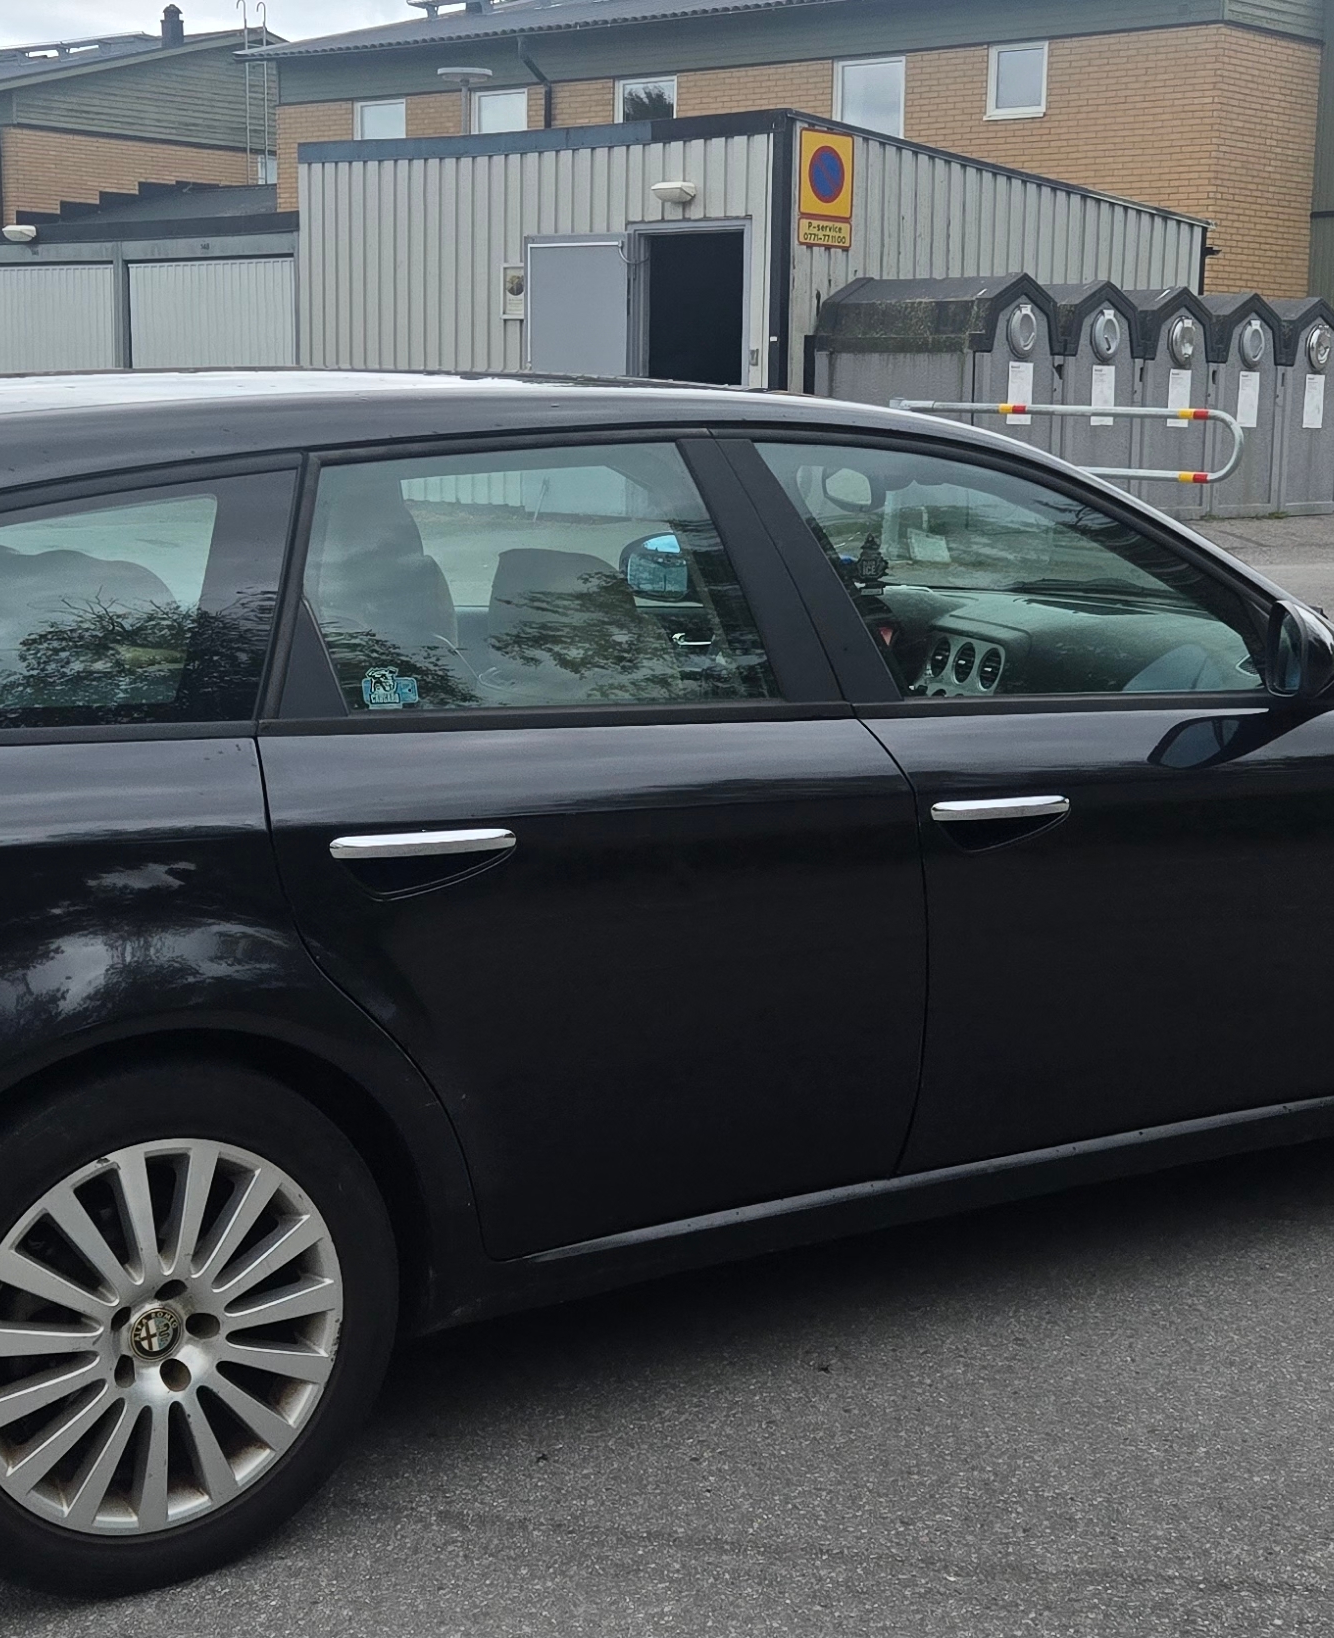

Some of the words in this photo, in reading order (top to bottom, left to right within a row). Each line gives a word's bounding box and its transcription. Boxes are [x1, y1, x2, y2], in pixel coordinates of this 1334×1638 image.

[808, 222, 842, 233] P-service
[803, 232, 829, 242] 0771-77
[862, 566, 876, 575] ICE
[151, 1312, 178, 1329] ROMEO
